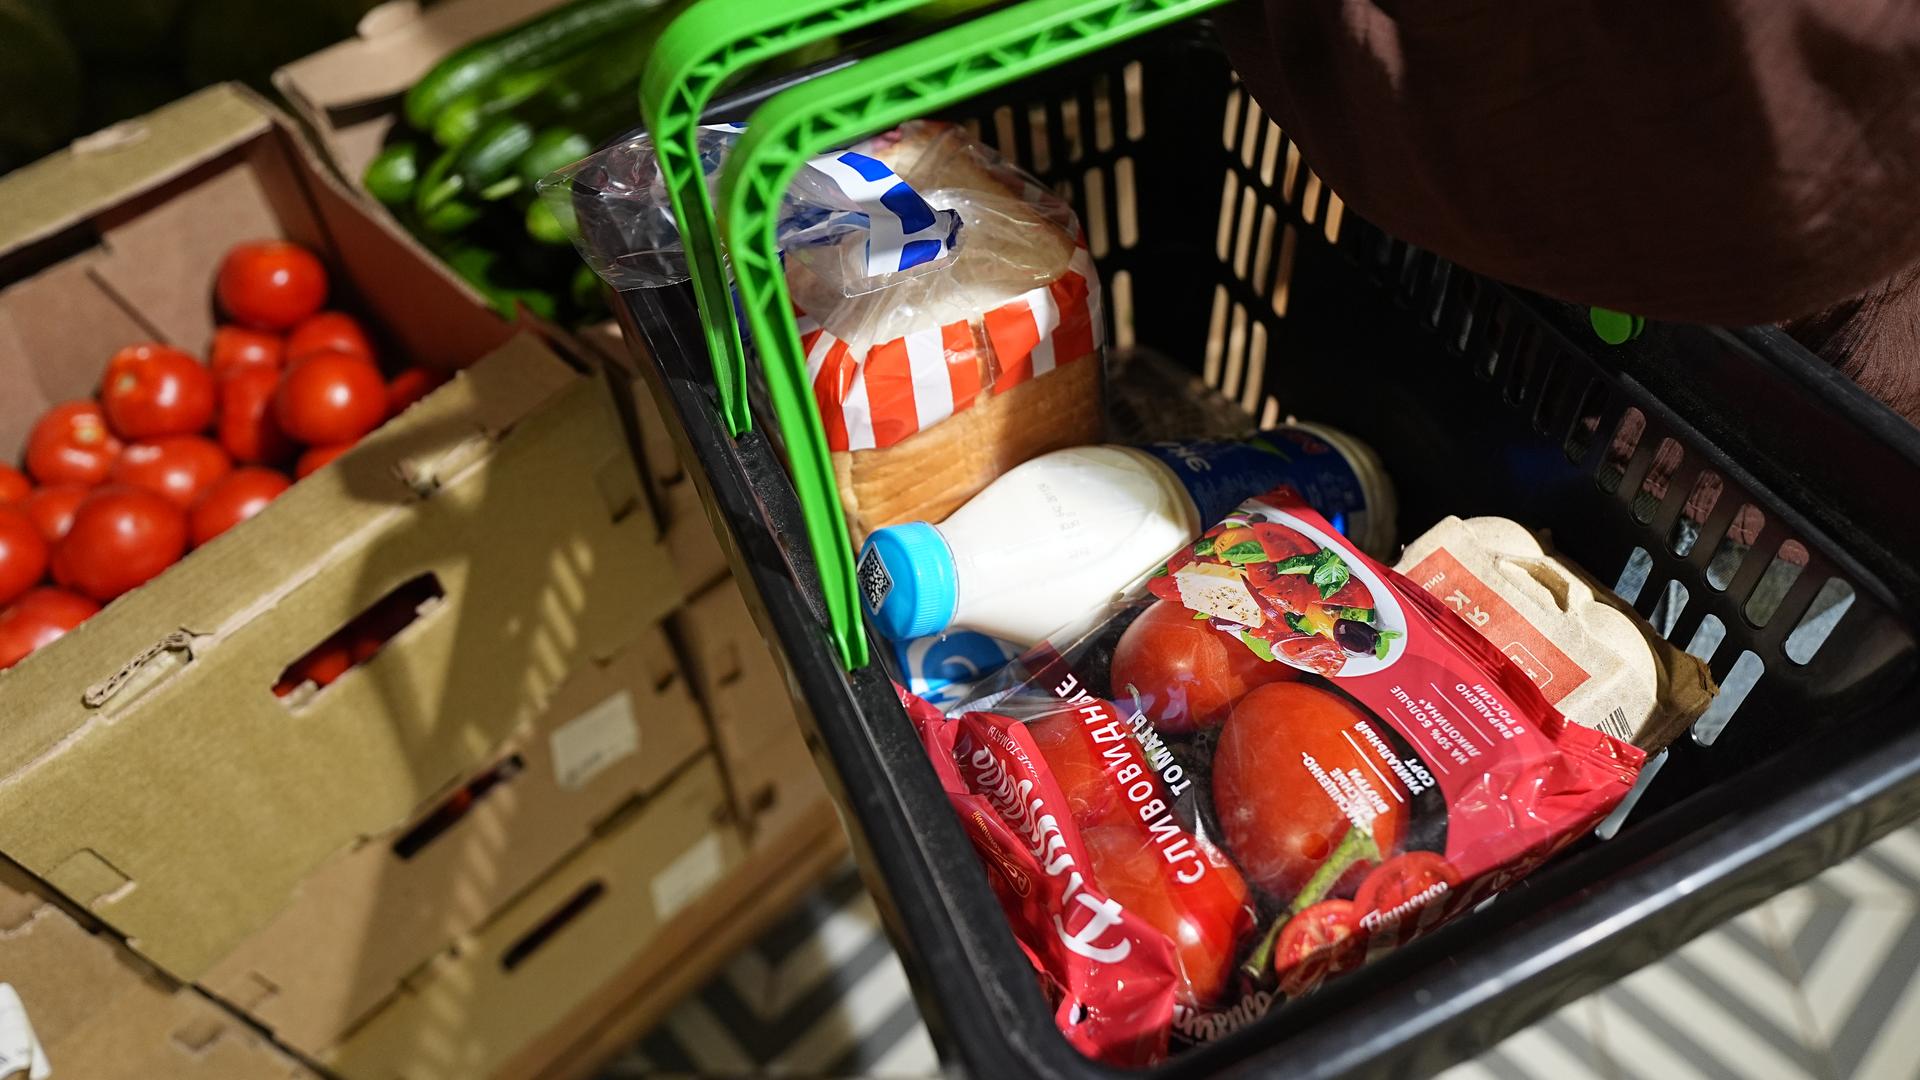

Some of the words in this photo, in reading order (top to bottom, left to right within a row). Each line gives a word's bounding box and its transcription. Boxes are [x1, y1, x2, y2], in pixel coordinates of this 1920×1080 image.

[1390, 685, 1433, 729] БОЛЬШЕ
[1455, 683, 1514, 740] ВЫРАЩЕНО
[1472, 683, 1516, 725] РОССИИ
[1430, 728, 1453, 750] 50%
[1513, 725, 1526, 735] В
[1126, 709, 1191, 797] ТОМАТЫ
[1353, 720, 1414, 796] УНИКАЛЬНЫЙ
[1404, 758, 1436, 788] СОРТ
[1450, 748, 1469, 766] НА
[1055, 673, 1205, 884] СЛИВОВИДНЫЕ
[1347, 768, 1391, 815] ВНУТРИ
